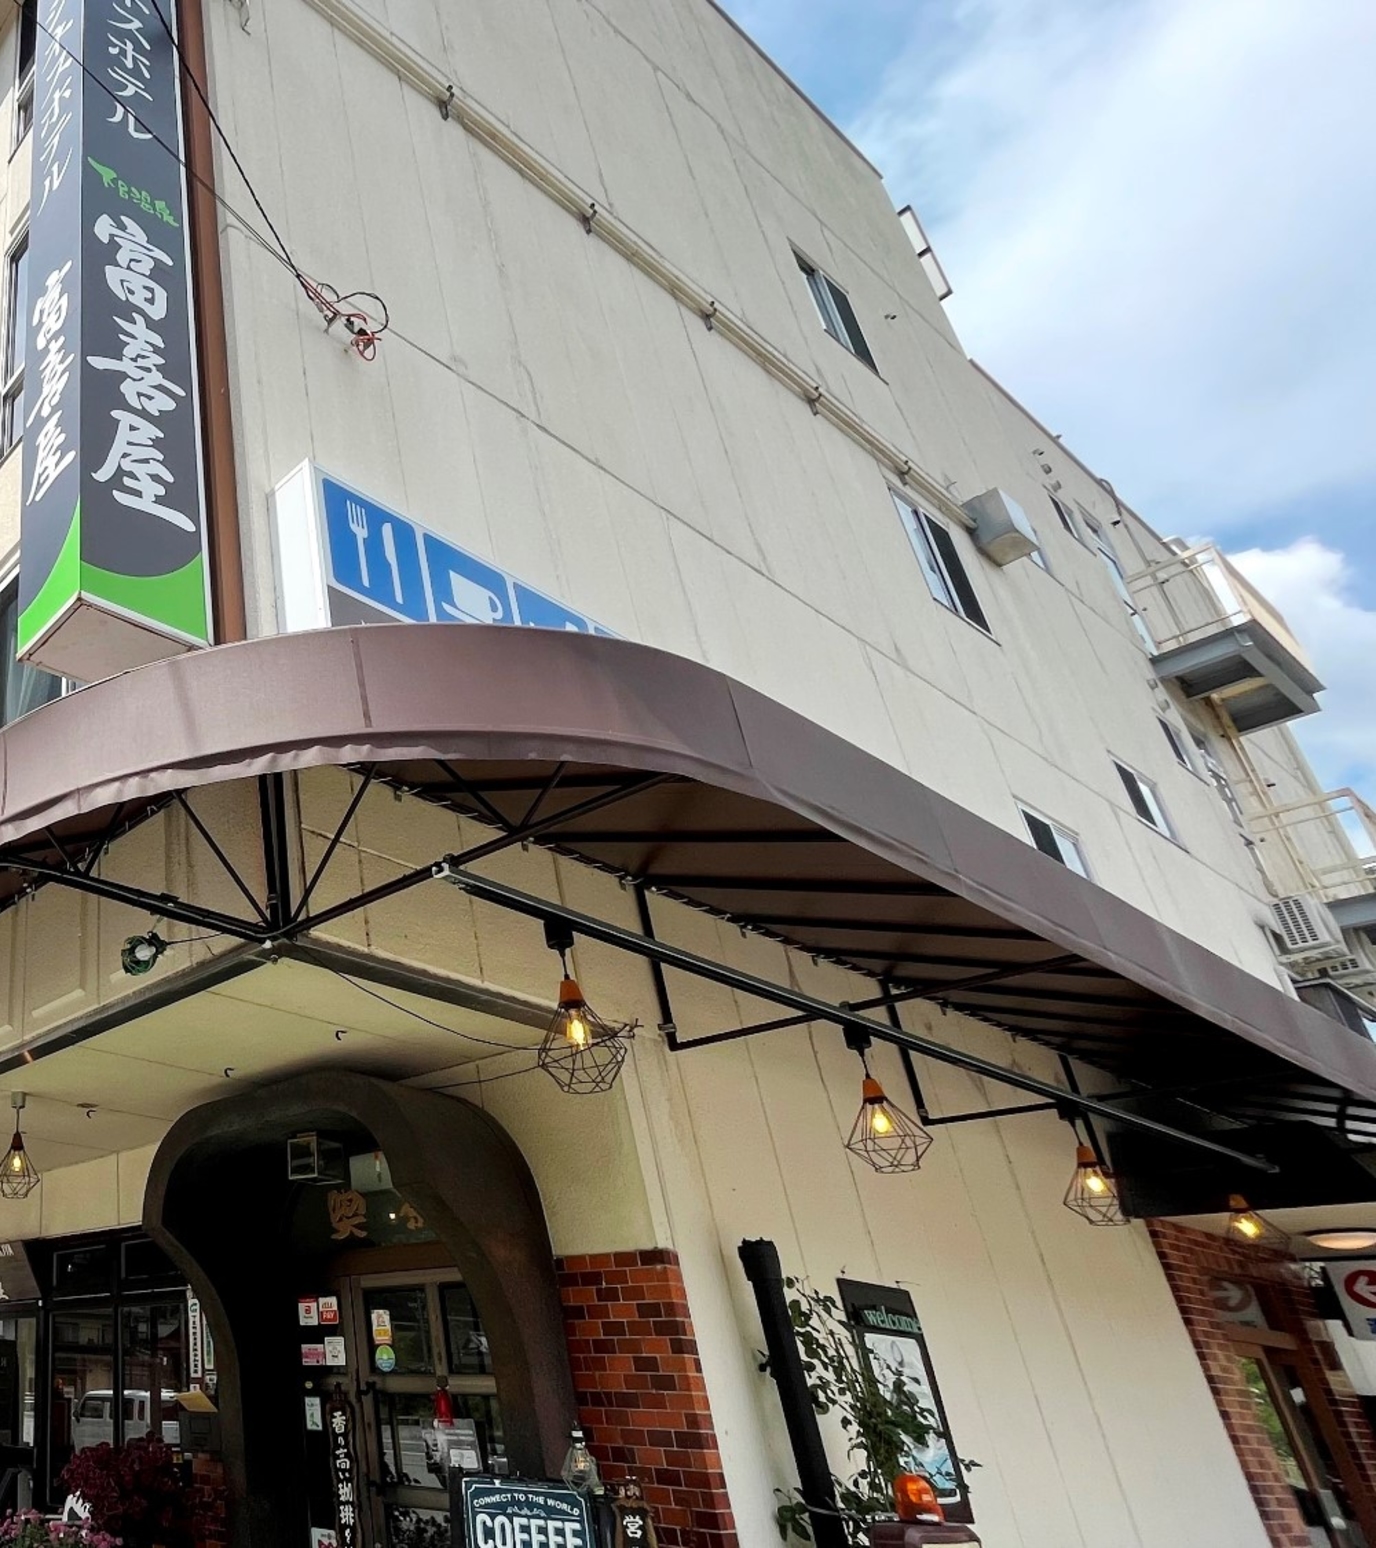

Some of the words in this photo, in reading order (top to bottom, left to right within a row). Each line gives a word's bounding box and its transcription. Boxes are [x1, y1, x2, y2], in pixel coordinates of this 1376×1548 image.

[25, 260, 77, 506] 富喜屋
[85, 214, 196, 532] 富喜屋
[863, 1305, 923, 1335] welcome
[331, 1410, 355, 1548] 香り高い珈琲を
[473, 1493, 512, 1508] CONNECT
[513, 1492, 527, 1502] TO
[528, 1494, 545, 1505] THE
[546, 1500, 580, 1516] WORLD
[475, 1513, 584, 1548] COFFEE
